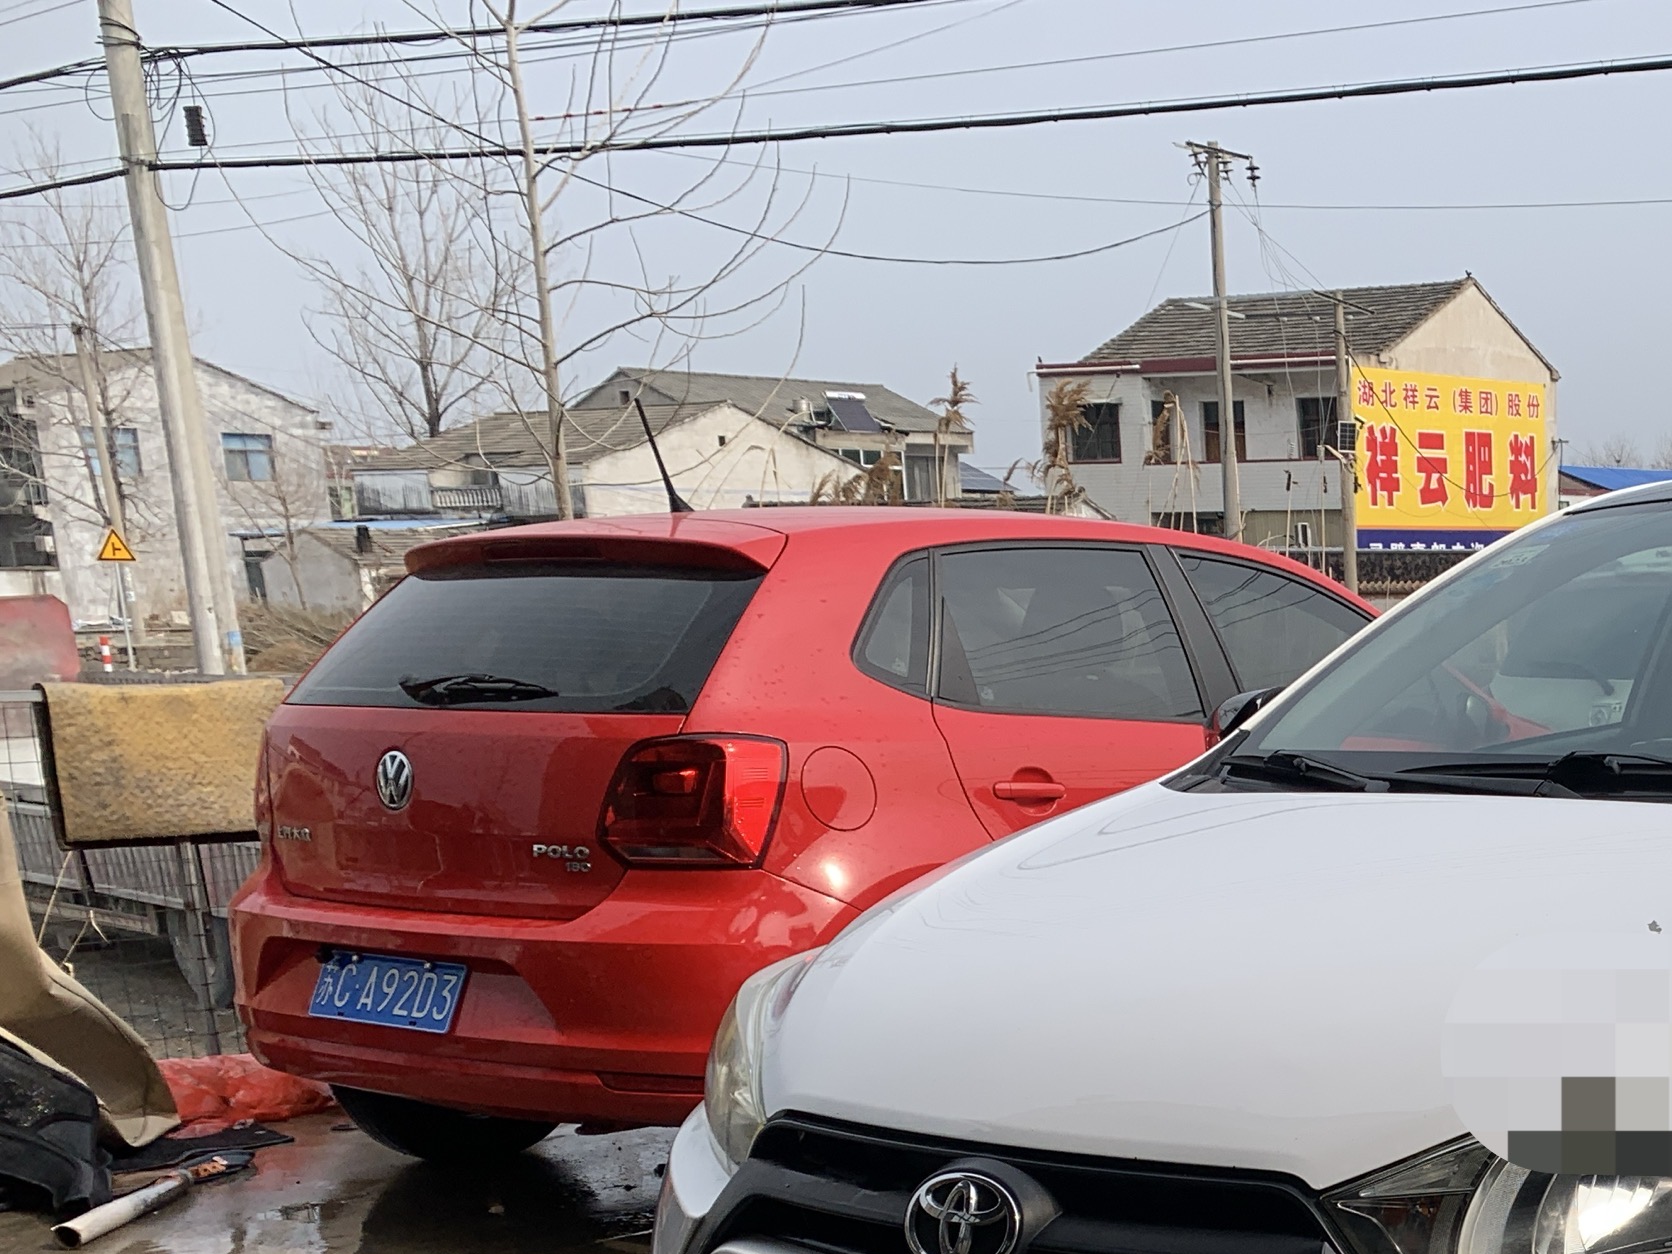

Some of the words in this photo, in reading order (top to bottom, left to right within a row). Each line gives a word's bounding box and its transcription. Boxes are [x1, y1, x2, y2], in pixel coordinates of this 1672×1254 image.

[1365, 423, 1539, 512] 祥云肥料
[532, 844, 590, 858] POLO
